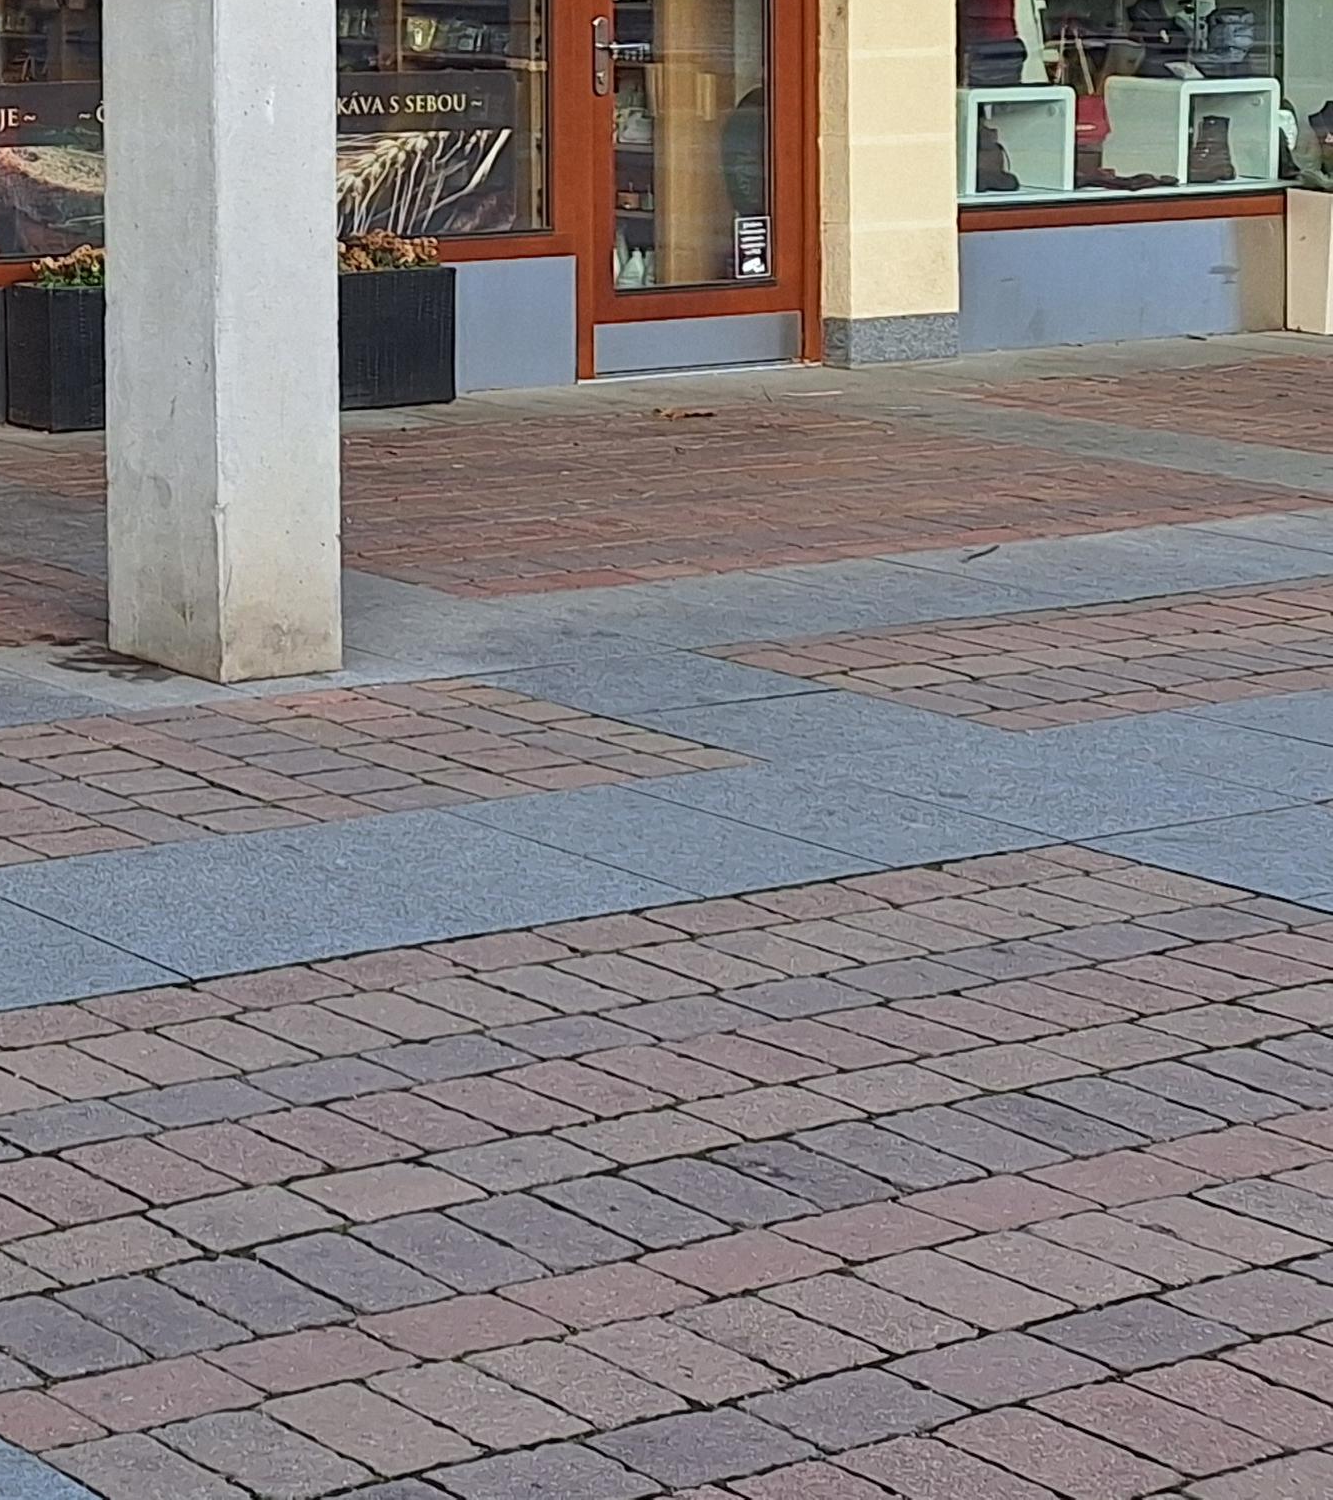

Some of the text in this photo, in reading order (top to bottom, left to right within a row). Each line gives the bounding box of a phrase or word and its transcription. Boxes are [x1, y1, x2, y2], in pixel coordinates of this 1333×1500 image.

[337, 92, 467, 115] KÁVA S SEBOU
